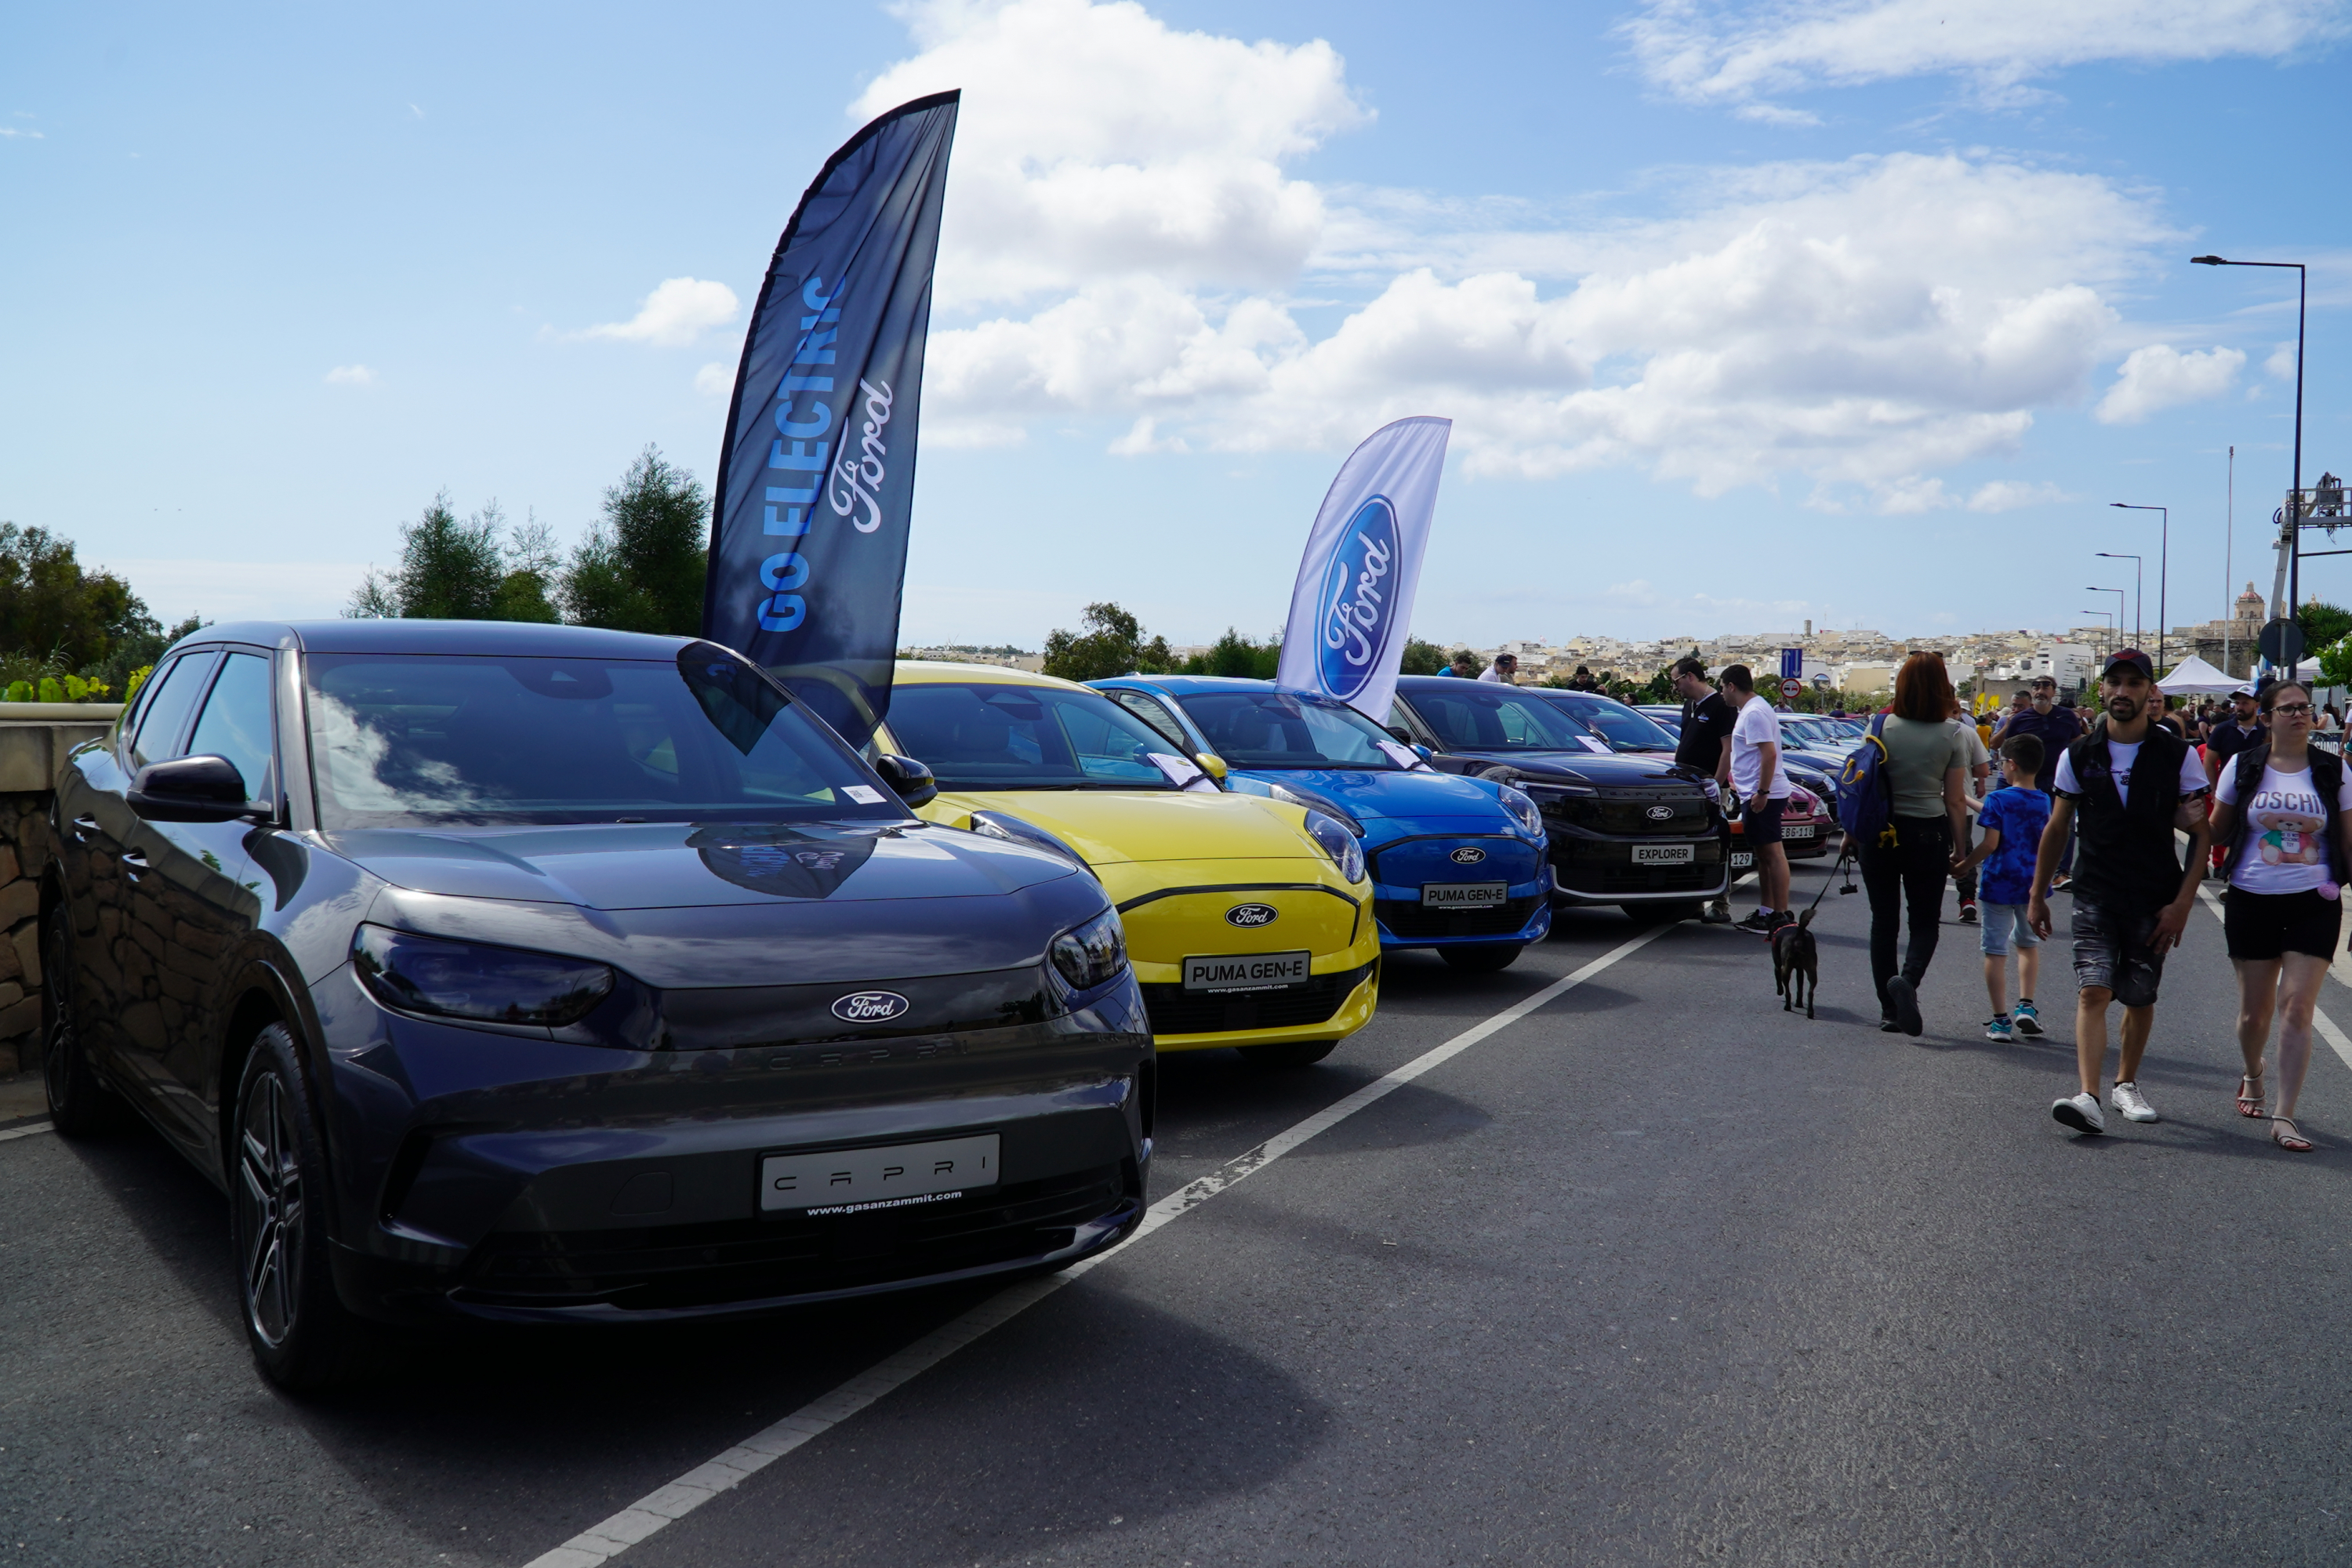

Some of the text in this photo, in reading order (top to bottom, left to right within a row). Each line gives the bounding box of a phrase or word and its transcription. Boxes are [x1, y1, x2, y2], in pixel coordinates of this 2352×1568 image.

[757, 276, 845, 632] GO ELECTRIC
[828, 378, 893, 532] Ford
[1326, 531, 1391, 666] Ford
[1652, 808, 1668, 818] Ford
[1457, 849, 1480, 862] Ford
[1639, 848, 1688, 859] EXPLORER
[1428, 888, 1503, 902] PUMA GEN-E
[1236, 907, 1269, 924] Ford
[1192, 960, 1303, 982] PUMA GEN-E
[1207, 983, 1288, 993] www.gasanzammit.com
[848, 995, 895, 1018] Ford
[769, 1040, 967, 1070] CAPRI
[774, 1156, 986, 1191] CAPRI
[808, 1190, 963, 1216] www.gasanzammit.com
